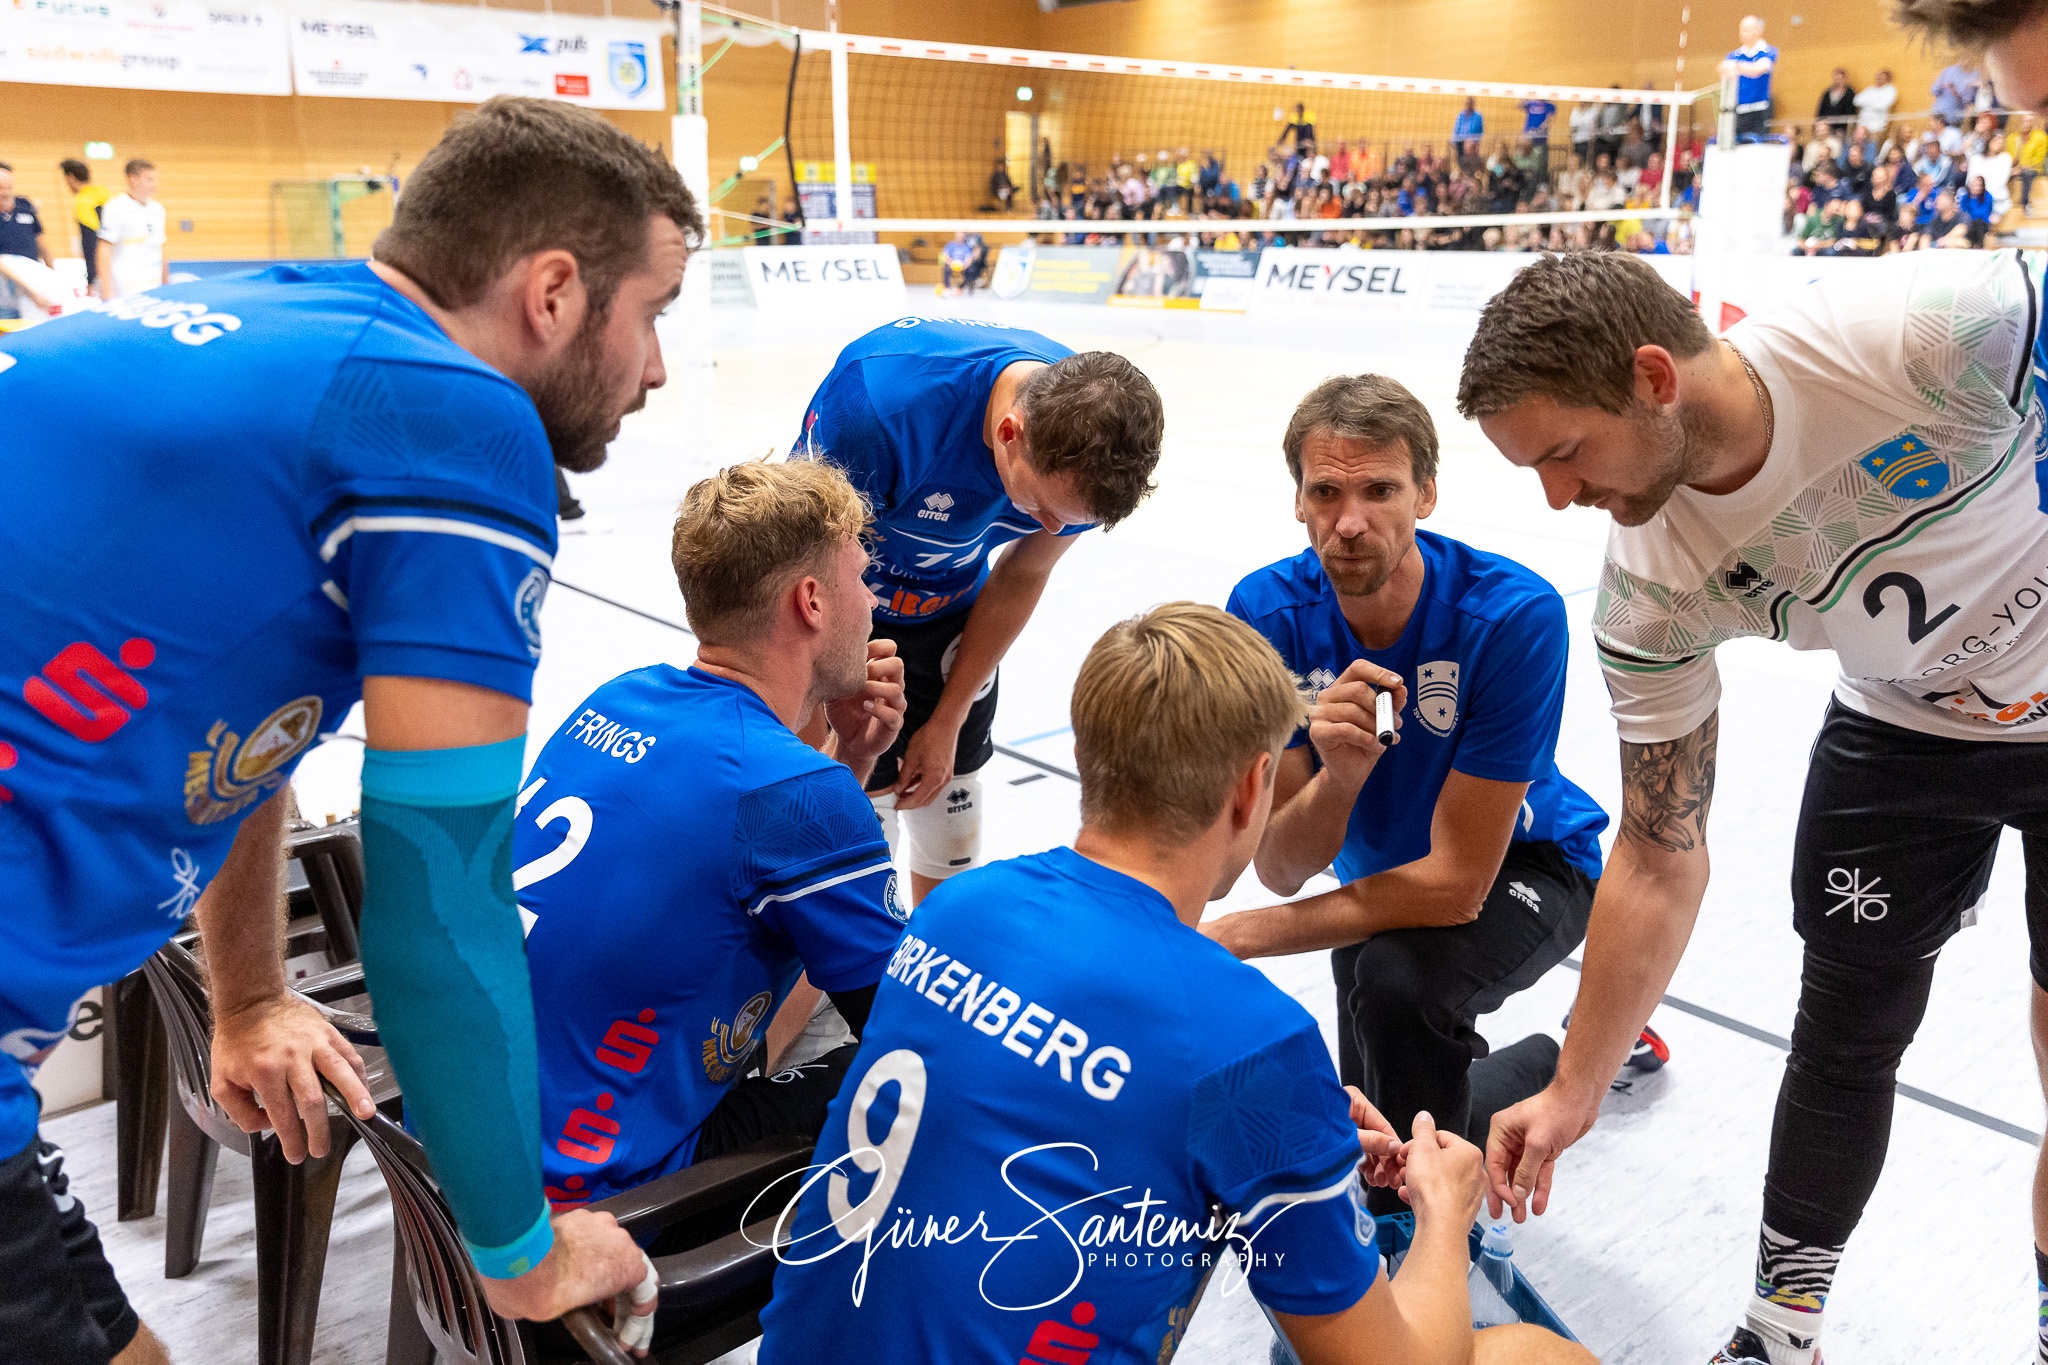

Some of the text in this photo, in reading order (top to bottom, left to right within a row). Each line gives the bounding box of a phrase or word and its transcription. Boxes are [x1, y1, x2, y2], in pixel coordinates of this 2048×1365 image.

[1267, 264, 1407, 294] MEYSEL
[917, 509, 950, 522] errea
[1862, 571, 1962, 645] 2
[565, 708, 657, 764] FRINGS
[1508, 888, 1540, 913] errea
[886, 934, 1132, 1102] BIRKENBERG
[827, 1048, 928, 1243] 9
